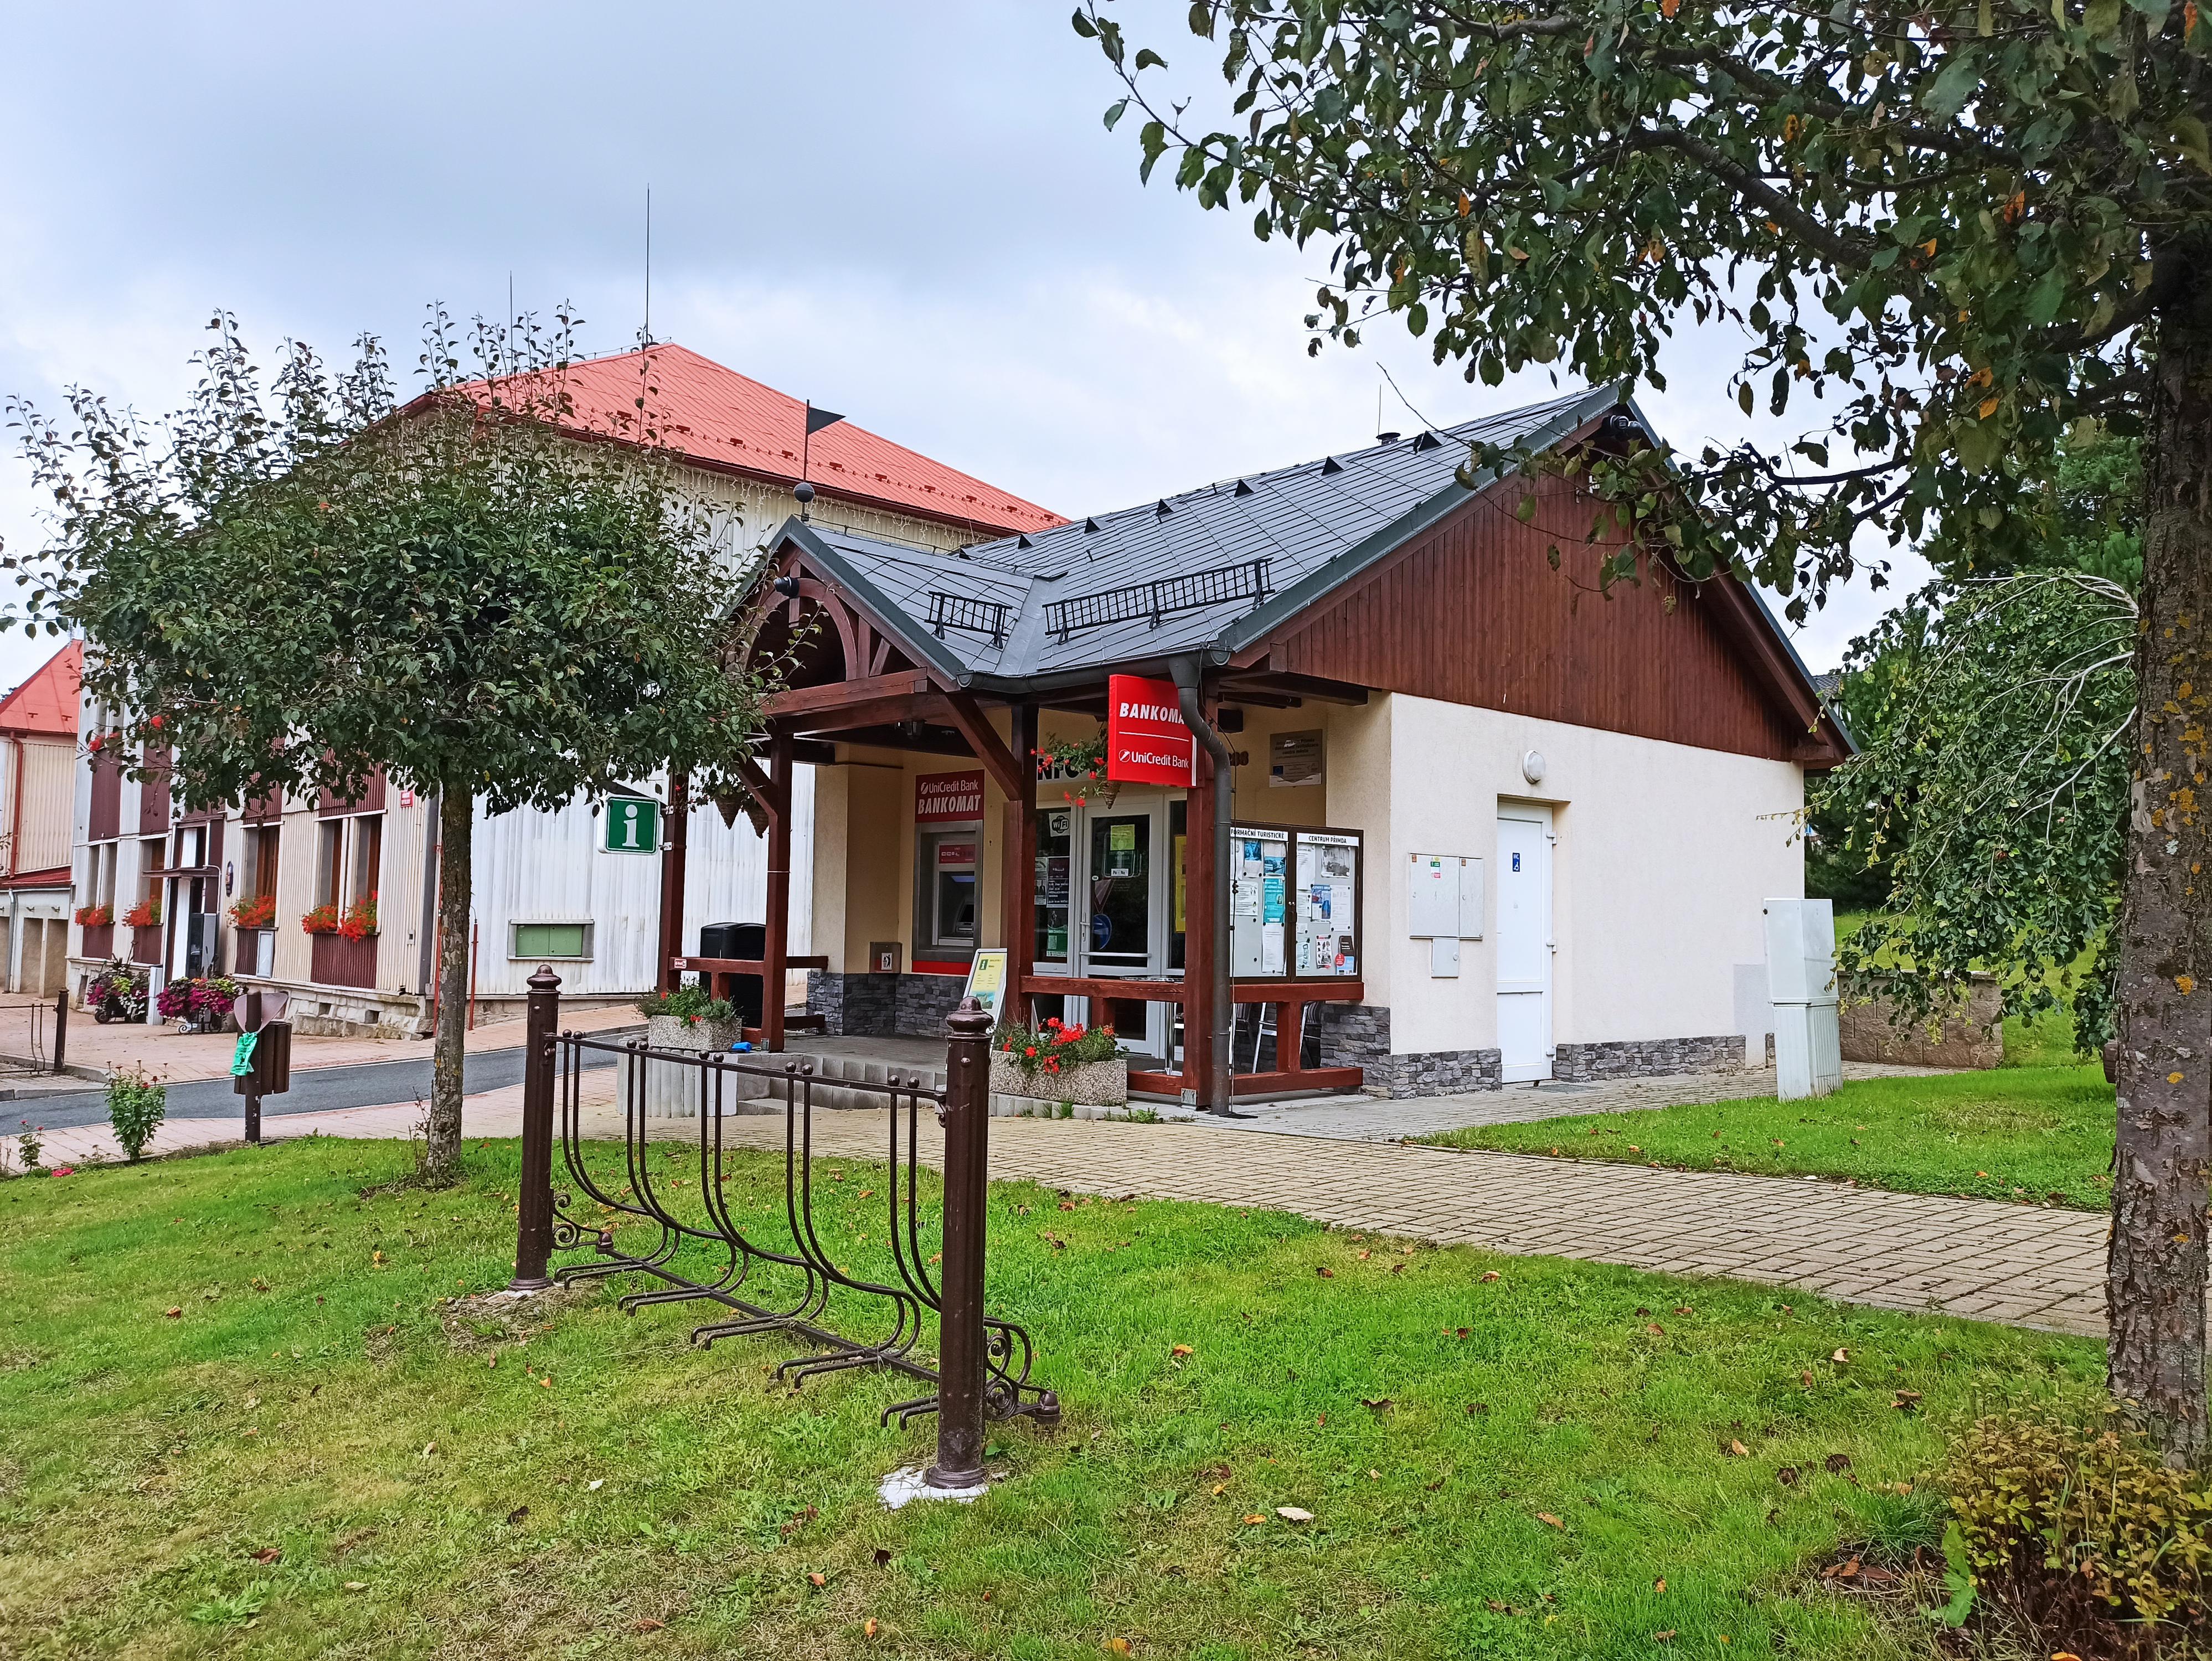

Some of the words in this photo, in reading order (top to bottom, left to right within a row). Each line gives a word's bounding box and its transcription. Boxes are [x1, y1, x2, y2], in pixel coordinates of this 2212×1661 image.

[1119, 702, 1184, 725] BANKOMA
[1038, 757, 1080, 780] NFO
[1131, 751, 1171, 766] UniCredit
[1172, 755, 1189, 769] Bank
[929, 780, 959, 793] UniCredit
[961, 779, 978, 791] Bank
[918, 795, 981, 814] BANKOMAT
[1231, 828, 1256, 837] FORMAČNÍ
[1331, 835, 1347, 844] PŘIMDA
